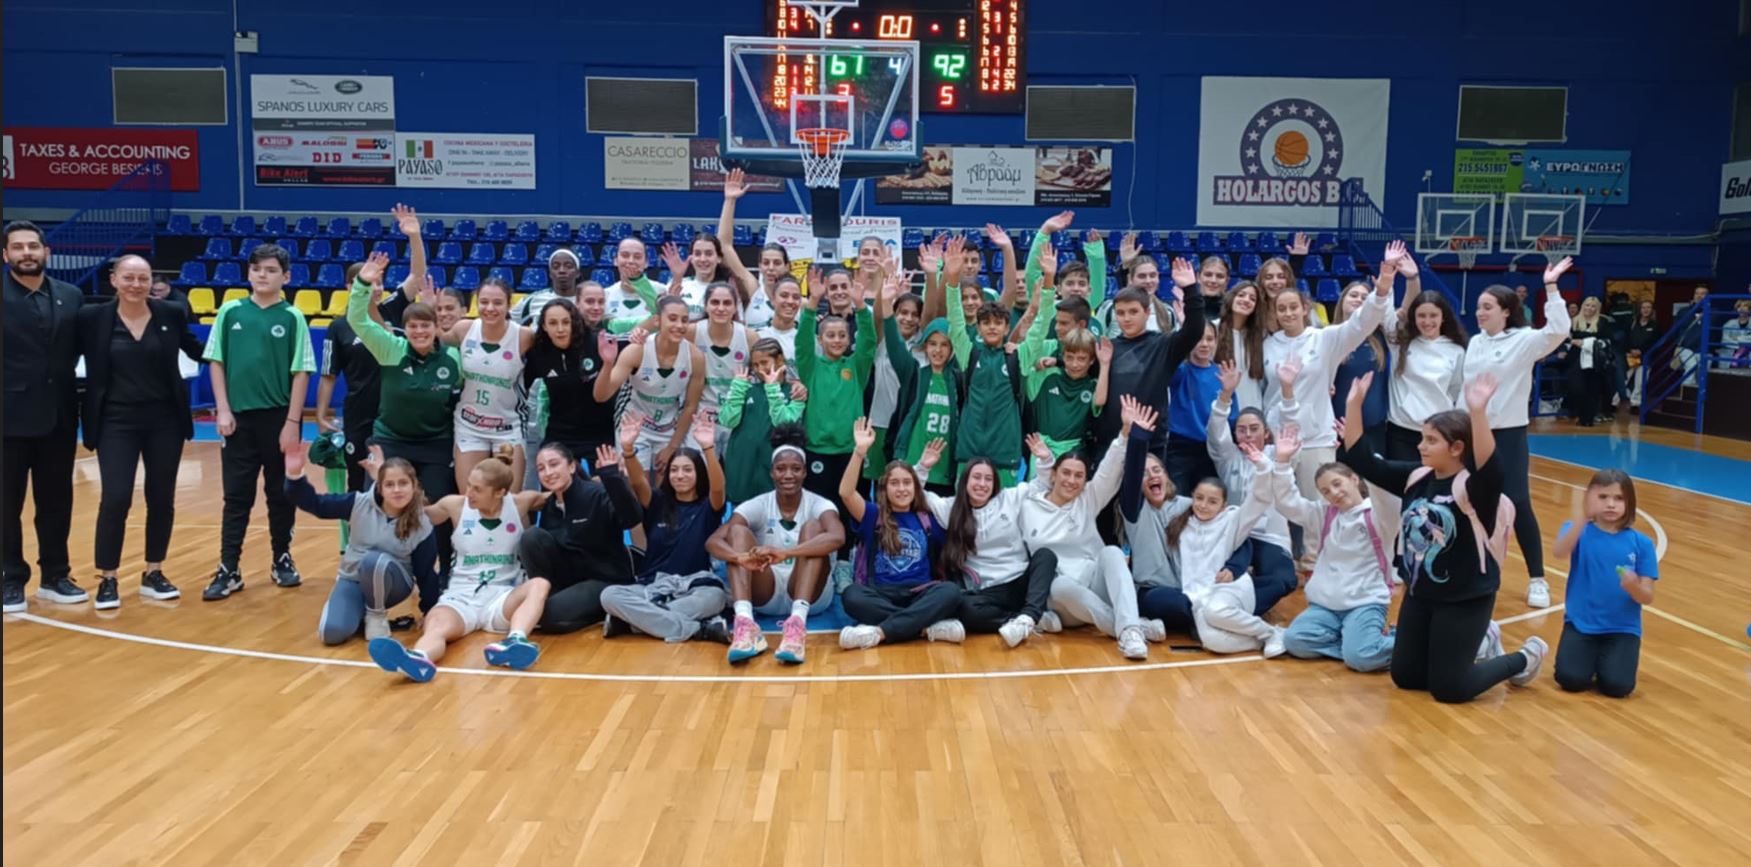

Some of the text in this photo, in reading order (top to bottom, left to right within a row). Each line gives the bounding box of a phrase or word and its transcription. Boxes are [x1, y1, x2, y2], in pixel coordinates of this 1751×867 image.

[831, 54, 965, 77] 67 4 92
[941, 85, 954, 105] 5
[257, 100, 389, 113] SPANOS LUXURY CARS
[19, 143, 191, 160] TAXES & ACCOUNTING
[608, 145, 688, 159] CASARECCIO
[49, 162, 108, 175] GEORGE
[398, 159, 443, 175] PAYASO
[1217, 178, 1322, 204] HOLARGOS
[475, 389, 490, 406] 15
[653, 409, 663, 422] 8
[927, 412, 950, 434] 28
